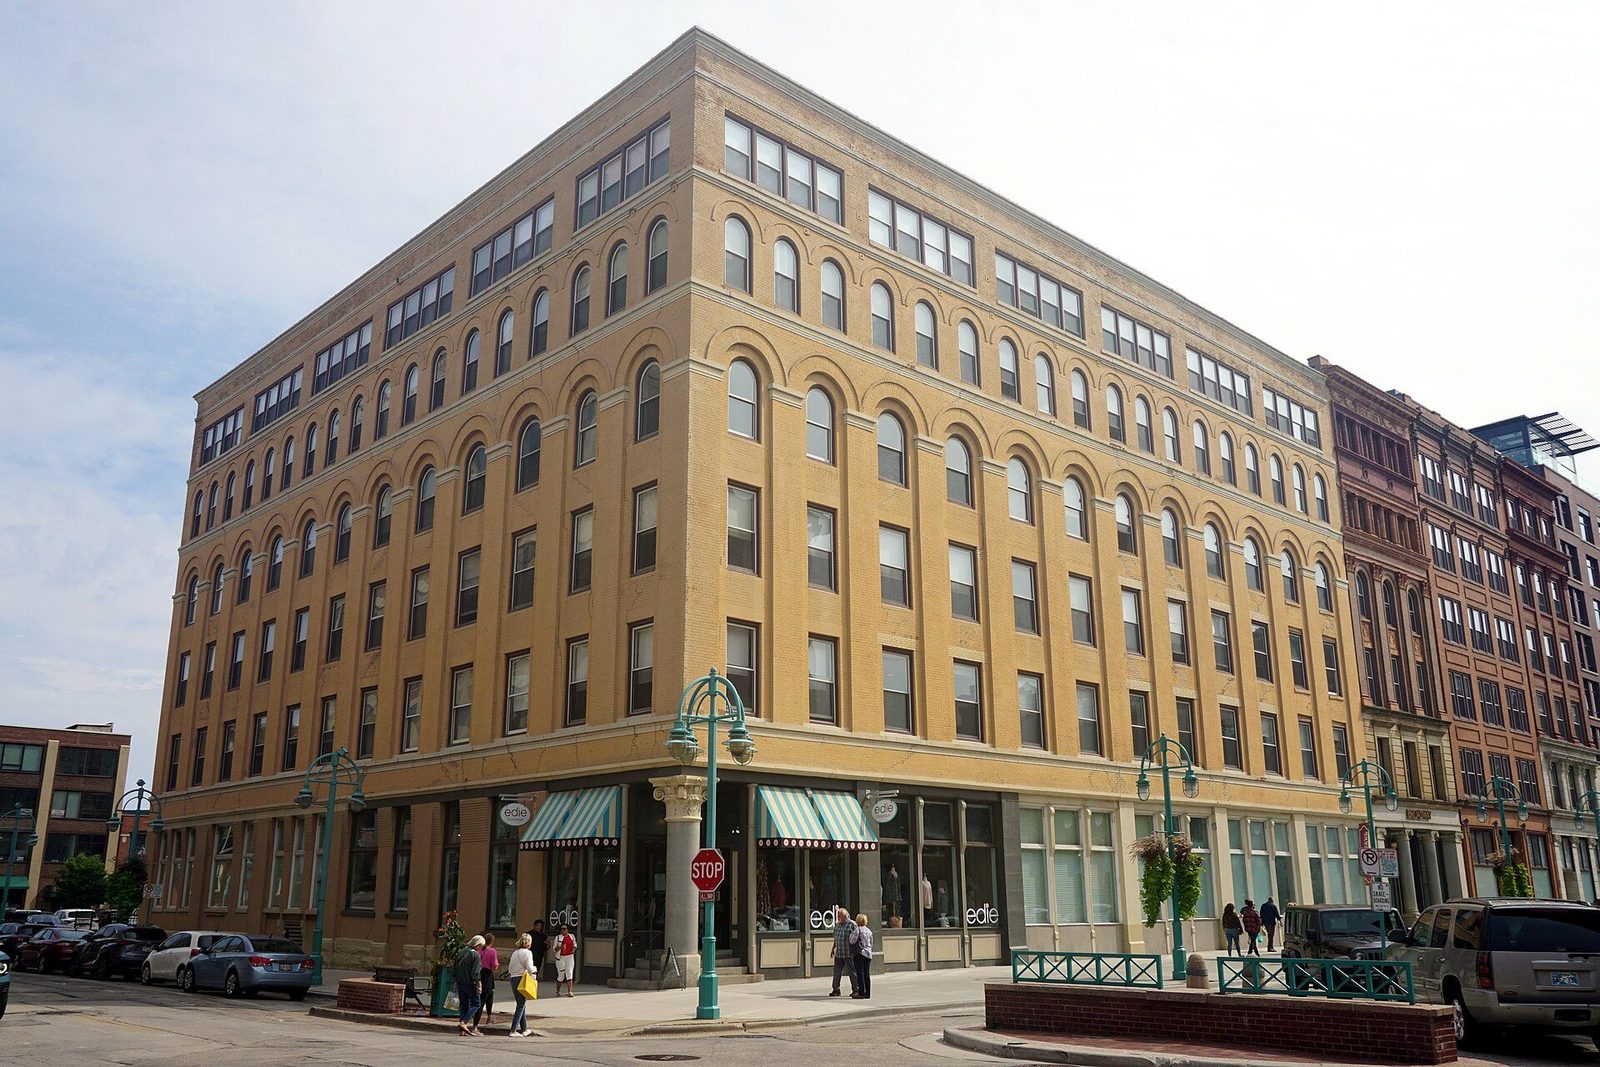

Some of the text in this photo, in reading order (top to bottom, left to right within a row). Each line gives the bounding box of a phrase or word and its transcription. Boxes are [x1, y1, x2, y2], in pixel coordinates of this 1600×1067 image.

[504, 807, 527, 818] edie
[692, 862, 722, 879] STOP
[549, 904, 579, 927] edie
[810, 905, 839, 928] edi
[966, 903, 999, 924] edie
